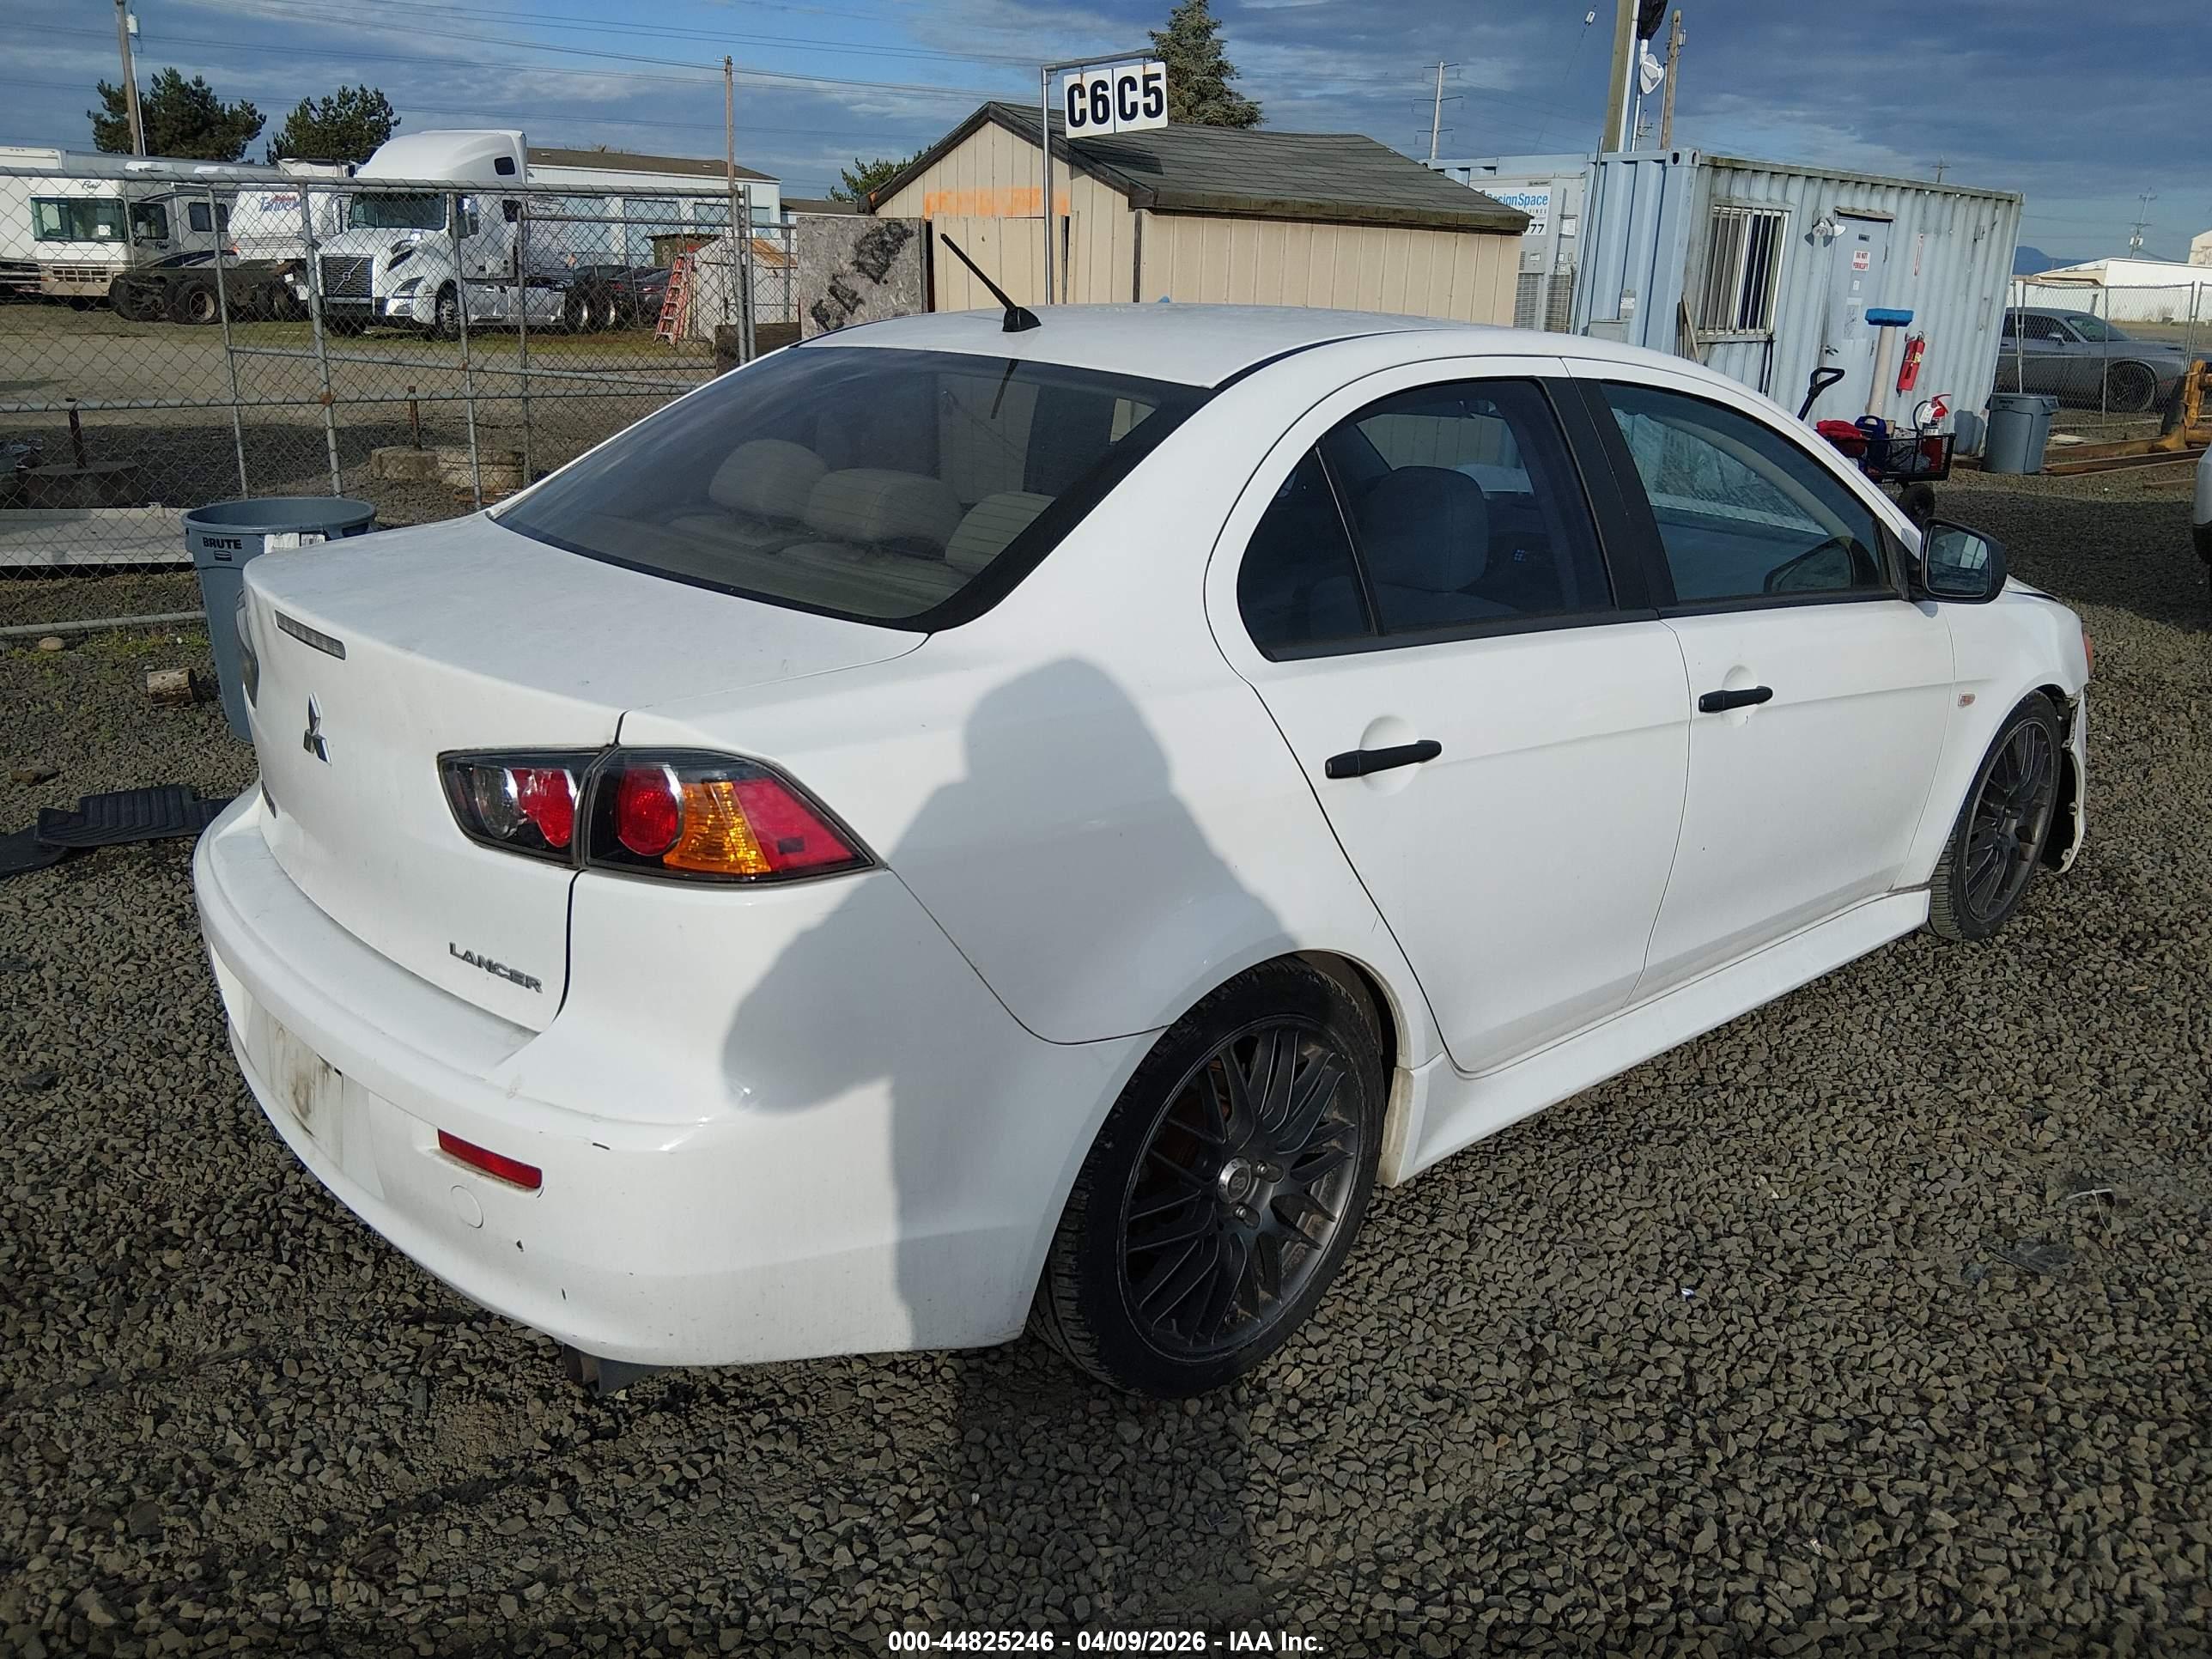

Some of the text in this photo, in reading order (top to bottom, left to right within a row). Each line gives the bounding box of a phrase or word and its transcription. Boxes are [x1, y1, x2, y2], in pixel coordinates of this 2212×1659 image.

[1067, 72, 1164, 128] C6 C5
[203, 537, 242, 550] BRUTE
[448, 941, 544, 994] LANCER
